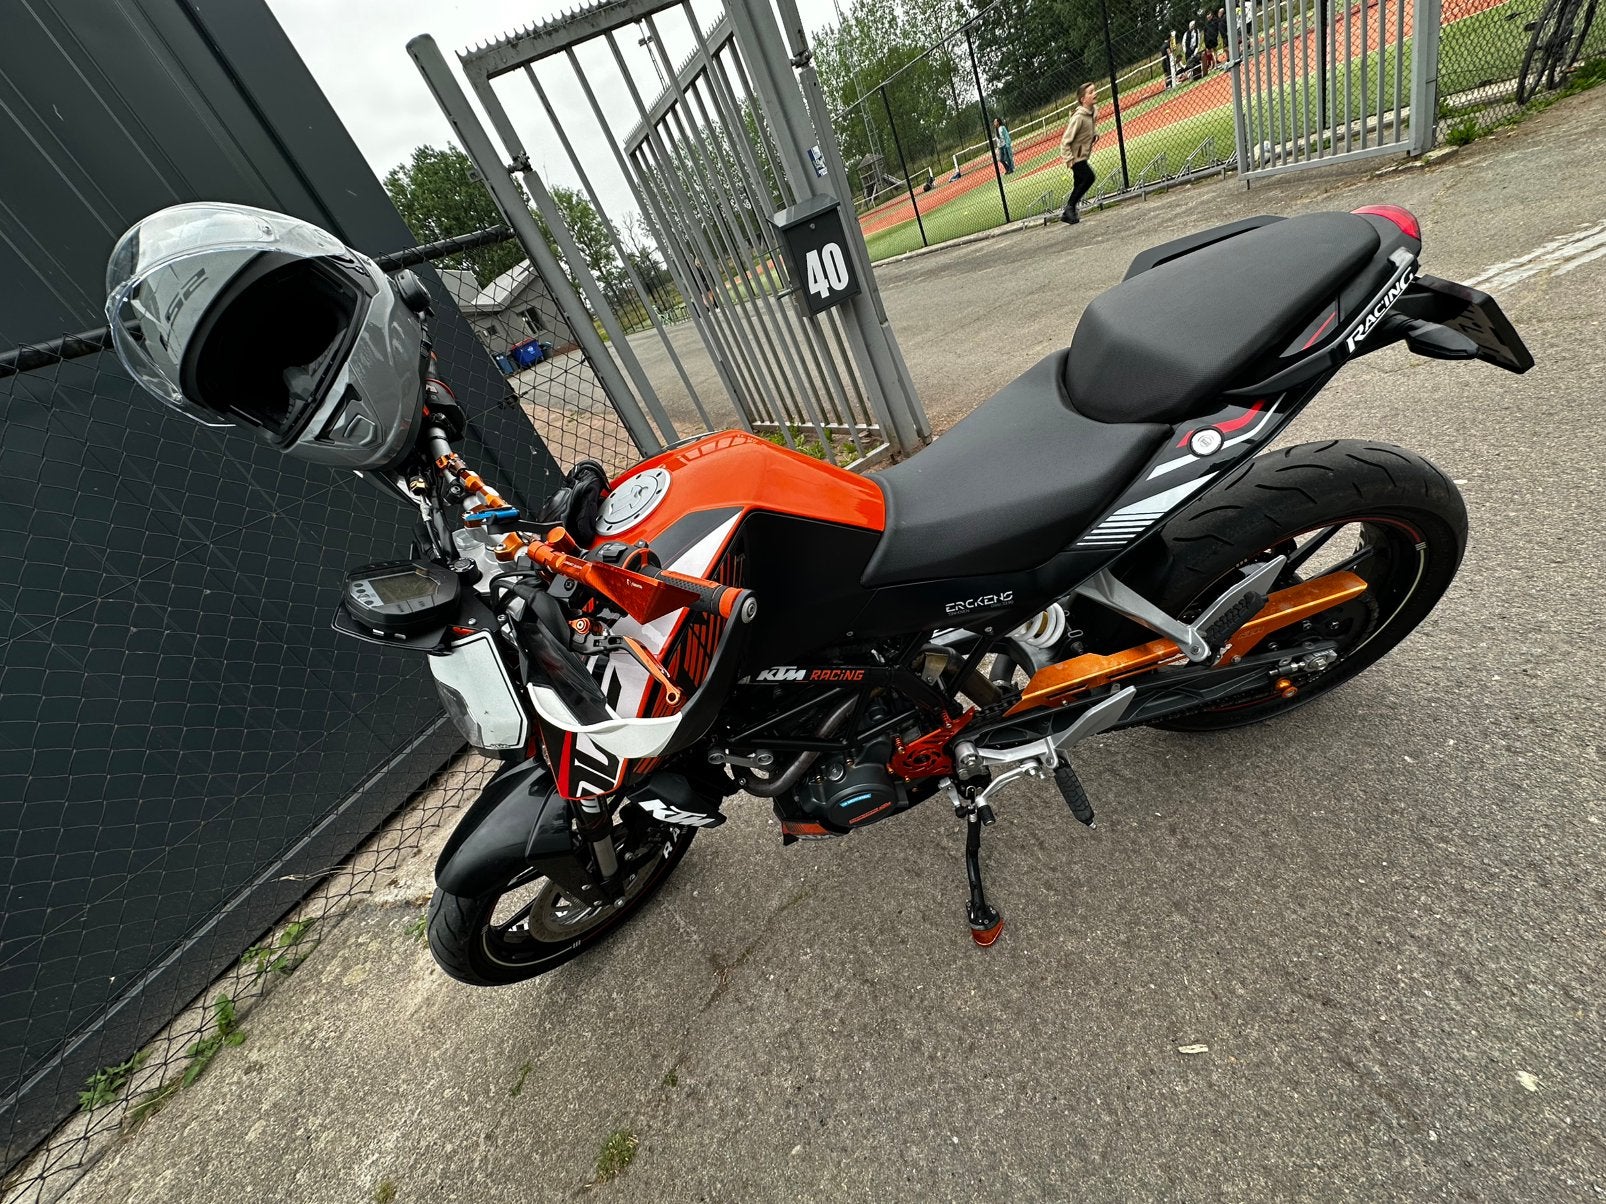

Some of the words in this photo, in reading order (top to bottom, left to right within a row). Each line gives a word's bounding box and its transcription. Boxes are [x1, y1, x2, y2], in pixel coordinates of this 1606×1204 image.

[805, 242, 849, 299] 40
[1345, 266, 1415, 354] RACING
[755, 666, 807, 681] KTM
[638, 799, 716, 827] KTM
